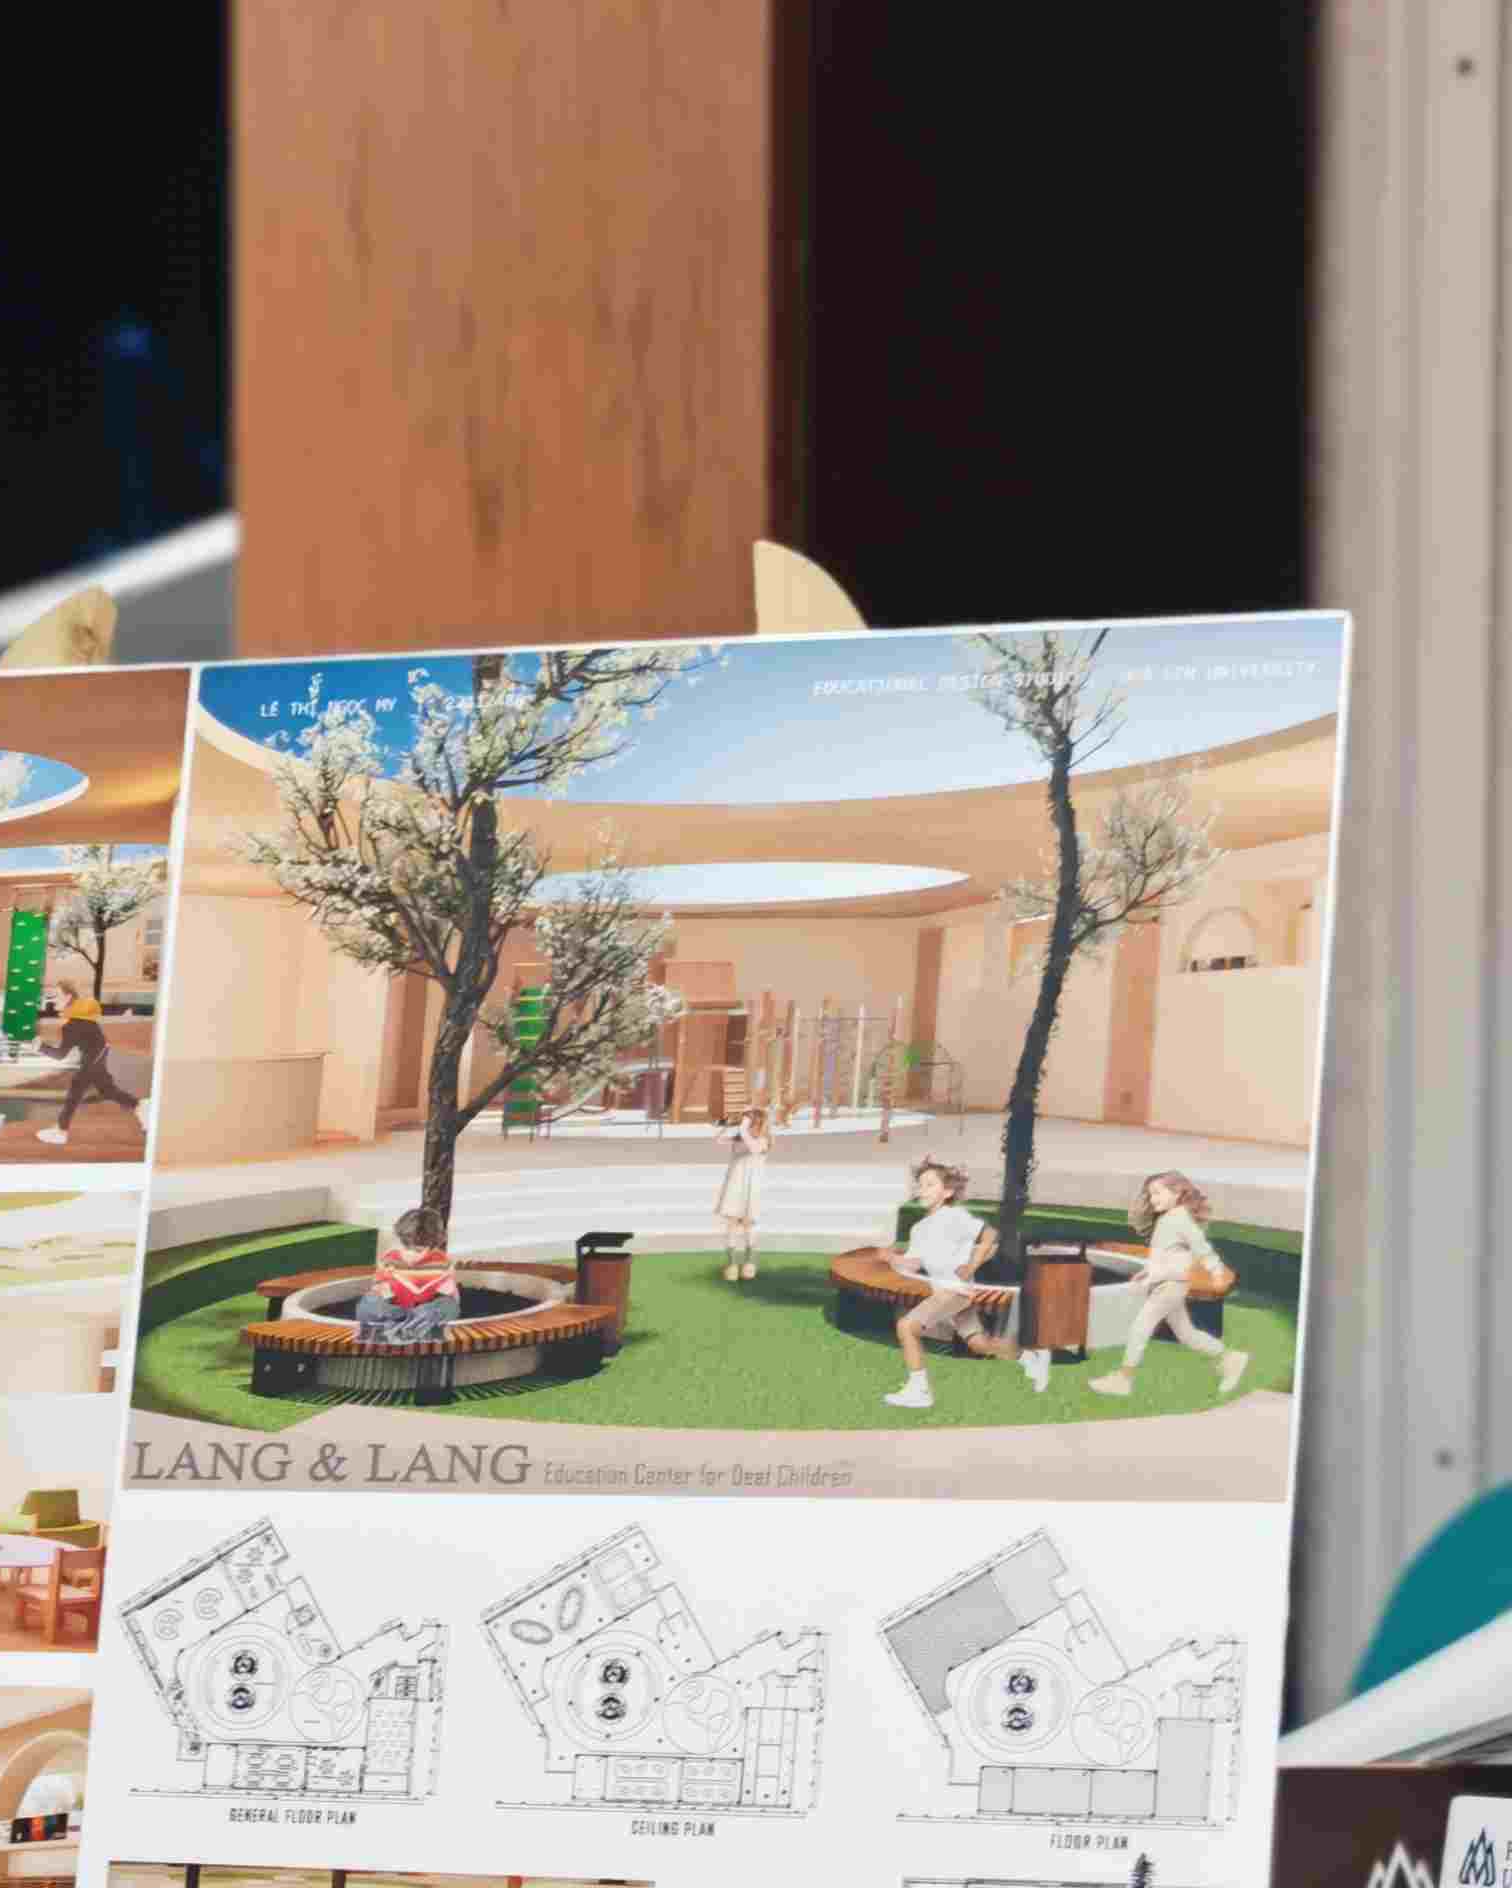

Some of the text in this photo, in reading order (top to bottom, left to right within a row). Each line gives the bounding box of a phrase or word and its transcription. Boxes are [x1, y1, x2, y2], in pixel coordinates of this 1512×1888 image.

[129, 1441, 533, 1486] LANG & LANG
[543, 1461, 854, 1488] Education Center for Deaf Children
[229, 1808, 356, 1825] GENERAL FLOOR PLAN
[631, 1820, 715, 1837] CEILING PLAN
